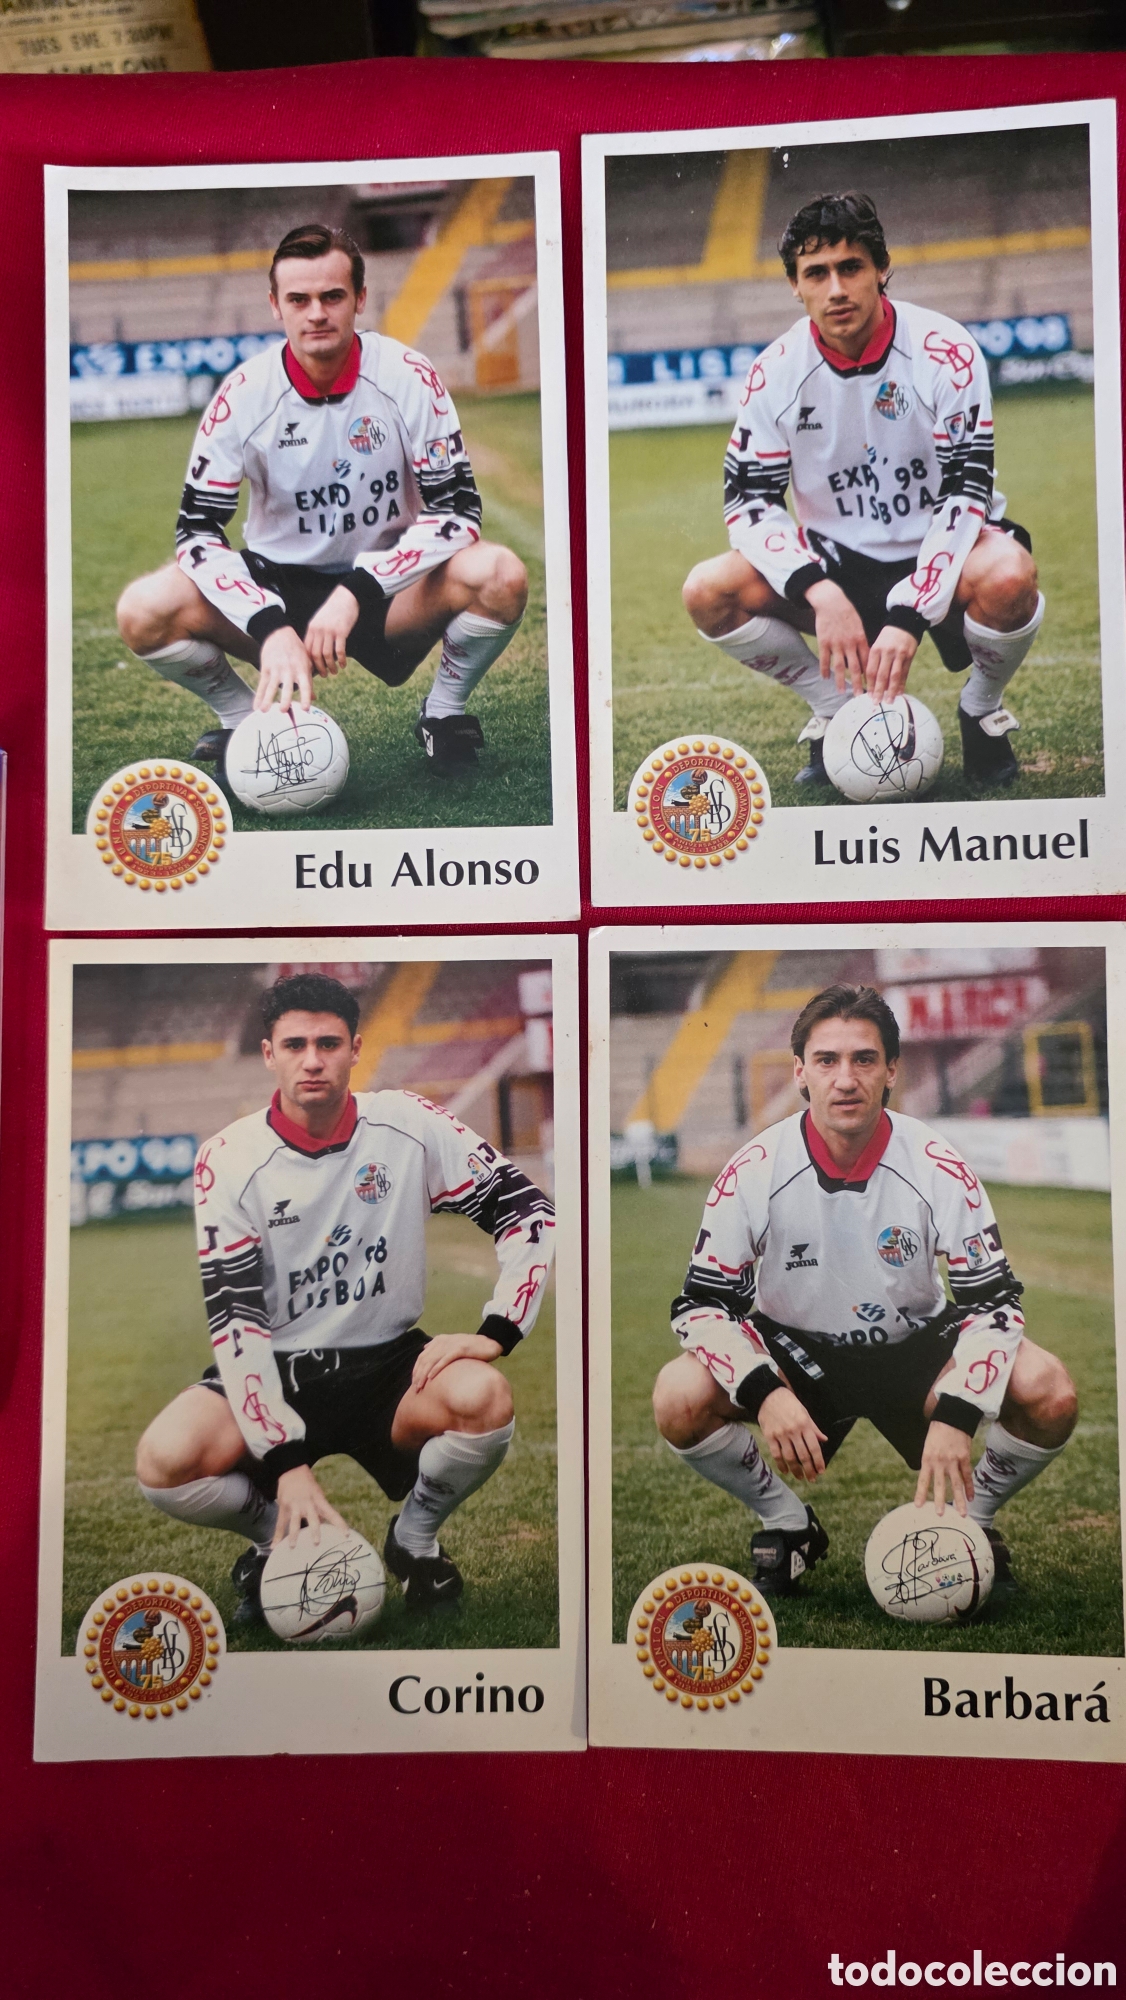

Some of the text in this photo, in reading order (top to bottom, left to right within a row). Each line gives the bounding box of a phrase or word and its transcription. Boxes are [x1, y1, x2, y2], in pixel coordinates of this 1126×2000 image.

[295, 483, 351, 512] EXPO
[836, 486, 935, 525] LISBOA
[671, 758, 726, 774] DEPORTIVA
[134, 782, 189, 798] DEPORTIVA
[652, 784, 666, 834] UNION
[731, 775, 748, 831] SALAMANCA
[112, 807, 127, 856] UNION
[193, 800, 210, 857] SALAMANCA
[689, 828, 712, 843] 75
[814, 818, 1089, 865] Luis Manuel
[149, 851, 173, 867] 75
[295, 848, 540, 889] Edu Alonso
[289, 1251, 349, 1295] EXPO
[125, 1597, 182, 1614] DEPORTIVA
[673, 1588, 731, 1606] DEPORTIVA
[102, 1624, 117, 1679] UNION
[187, 1617, 204, 1677] SALAMANCA
[652, 1614, 667, 1668] UNION
[736, 1610, 754, 1671] SALAMANCA
[140, 1674, 165, 1690] 75
[388, 1671, 545, 1715] Corino
[691, 1666, 716, 1682] 75
[923, 1676, 1111, 1723] Barbará
